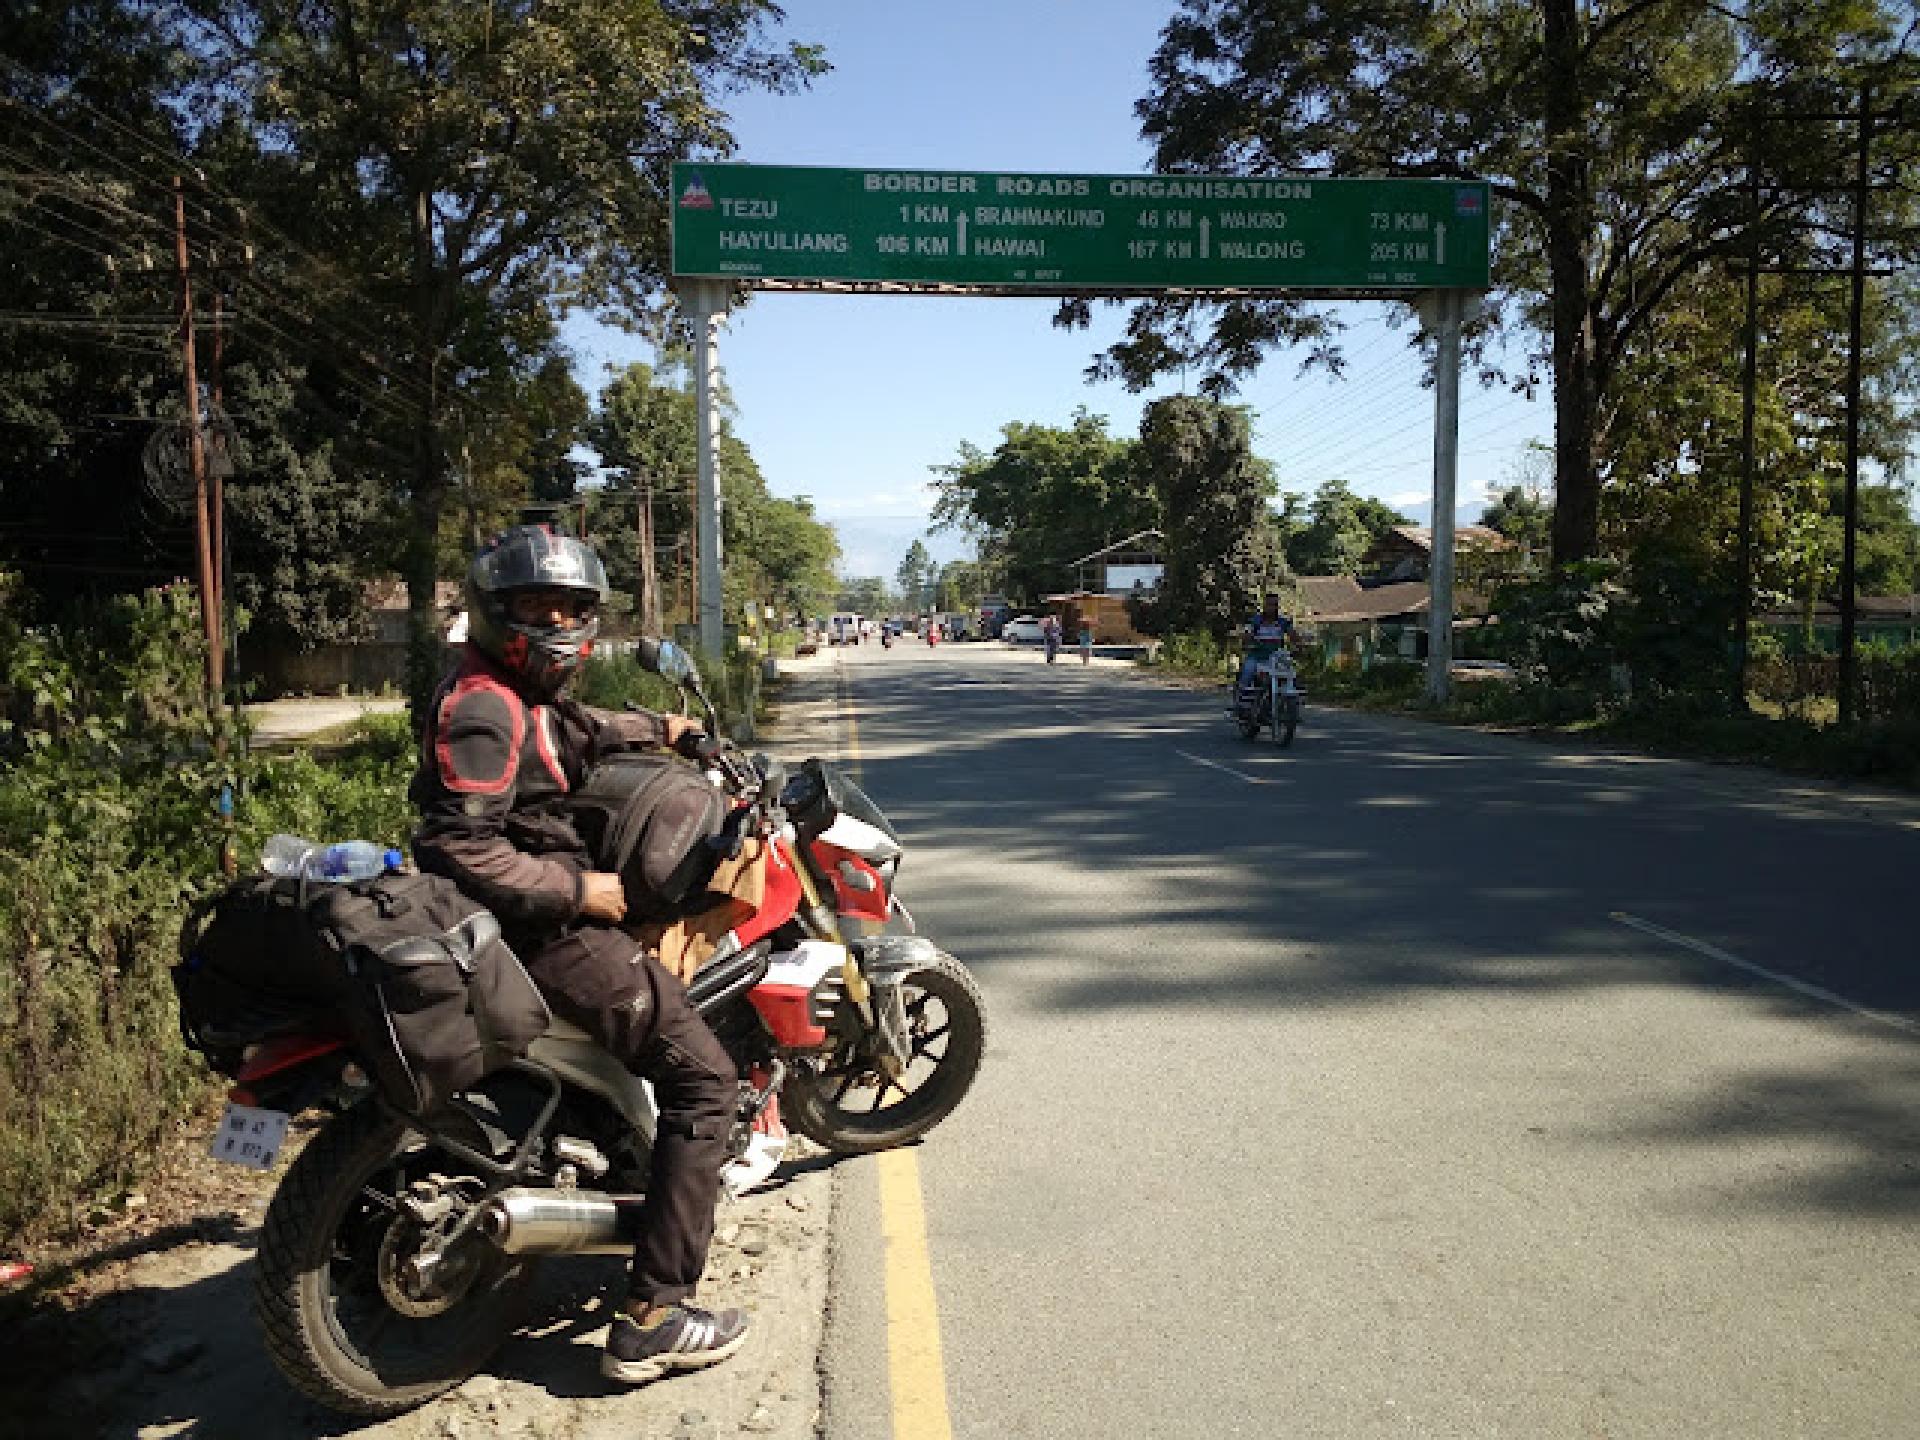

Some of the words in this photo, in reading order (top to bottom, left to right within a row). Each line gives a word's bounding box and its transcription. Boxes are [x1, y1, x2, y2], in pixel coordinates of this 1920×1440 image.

[864, 173, 977, 193] BORDER
[995, 177, 1090, 196] ROADS
[1110, 180, 1312, 200] ORGANISATION
[719, 198, 778, 220] TEZU
[899, 205, 909, 222] 1
[914, 205, 949, 222] KM
[974, 206, 1105, 228] BRAHMAKUND
[1137, 209, 1159, 229] 46
[1167, 209, 1192, 229] KM
[1218, 211, 1288, 230] WAKRO
[1369, 212, 1390, 232] 73
[1394, 212, 1429, 232] KM
[719, 230, 848, 253] HAYULIANG
[875, 233, 909, 253] 106
[914, 235, 949, 255] KM
[974, 236, 1045, 258] HAWAI
[1167, 240, 1192, 259] KM
[1218, 240, 1306, 259] WALONG
[1369, 242, 1399, 262] 205
[1403, 243, 1429, 262] KM
